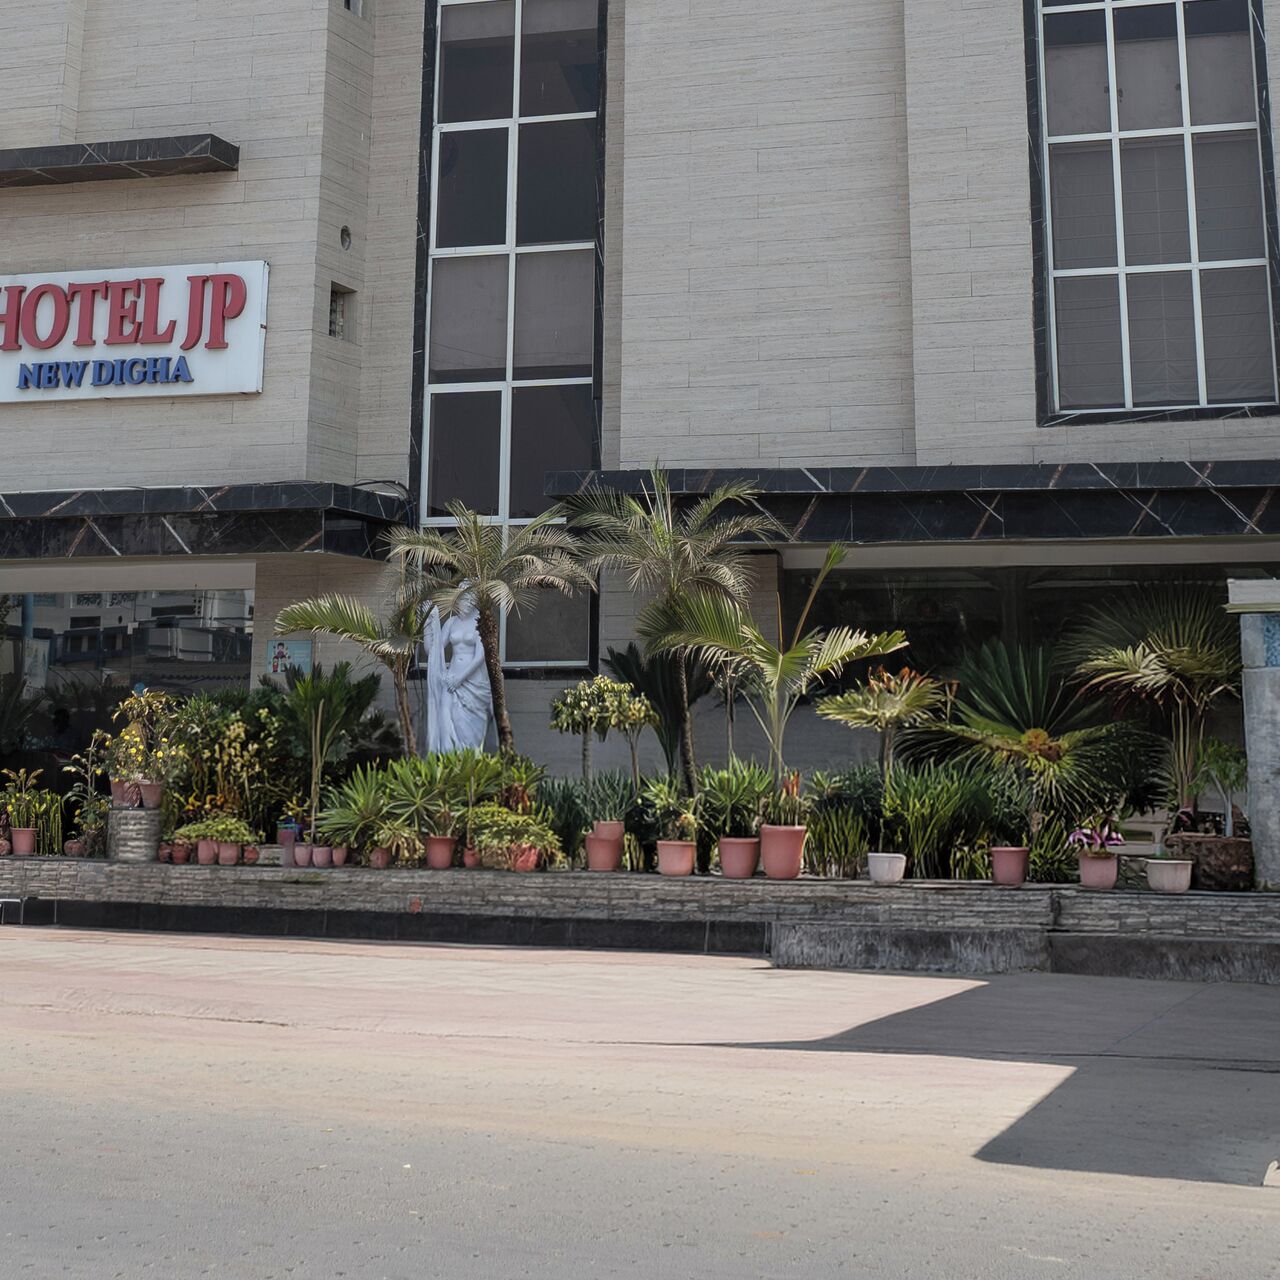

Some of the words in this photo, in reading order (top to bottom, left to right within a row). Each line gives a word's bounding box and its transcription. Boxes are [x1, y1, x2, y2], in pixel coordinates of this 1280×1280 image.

[180, 273, 248, 351] JP
[16, 360, 89, 389] NEW
[90, 355, 195, 387] DIGHA
